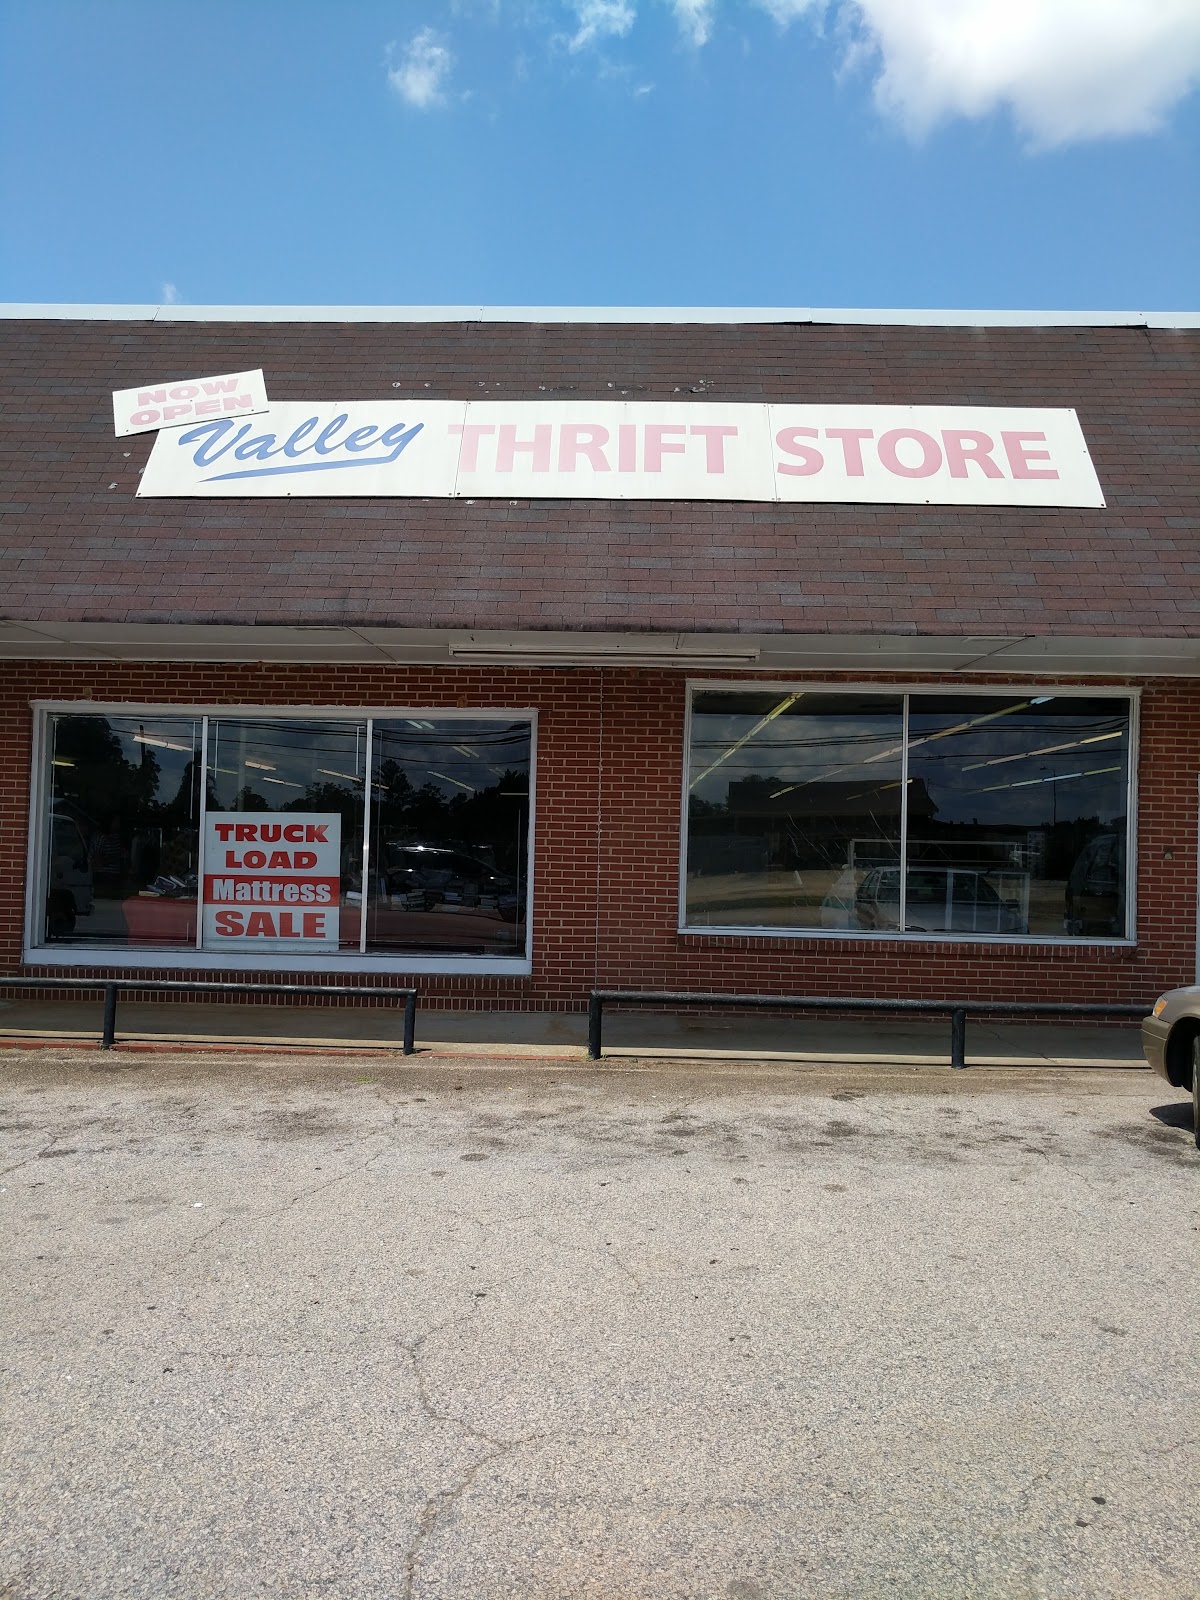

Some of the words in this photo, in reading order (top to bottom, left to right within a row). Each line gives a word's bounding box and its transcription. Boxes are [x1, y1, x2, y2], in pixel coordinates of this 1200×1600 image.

[137, 379, 239, 406] NOW
[129, 394, 253, 426] OPEN
[178, 413, 425, 483] Valley
[447, 424, 738, 474] THRIFT
[775, 426, 1060, 481] STORE
[214, 823, 330, 843] TRUCK
[225, 850, 318, 870] LOAD
[212, 878, 332, 903] Mattress
[214, 910, 327, 939] SALE
